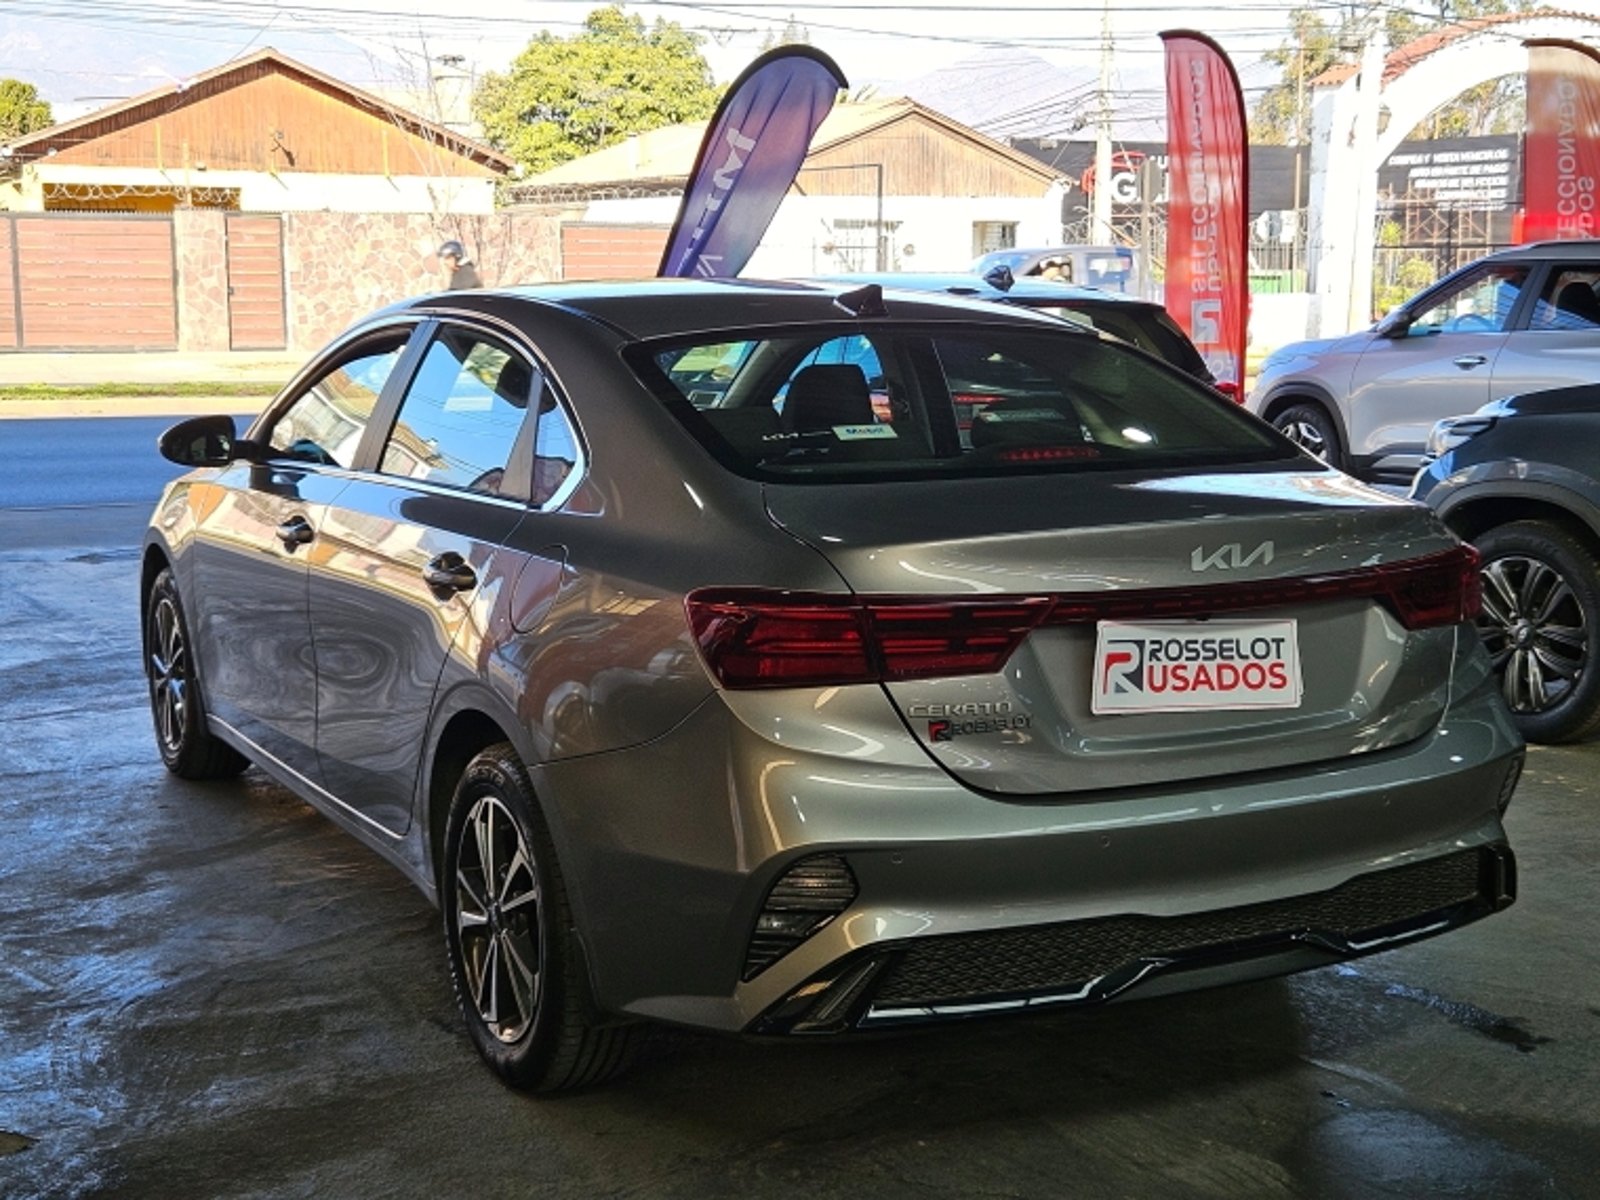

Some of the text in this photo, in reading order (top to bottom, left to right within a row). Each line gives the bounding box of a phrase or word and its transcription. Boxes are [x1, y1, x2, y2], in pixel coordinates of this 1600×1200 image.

[1191, 540, 1274, 571] KIA
[1149, 637, 1285, 661] ROSSELOT
[1147, 662, 1287, 693] USADOS
[908, 701, 1012, 718] CERATO
